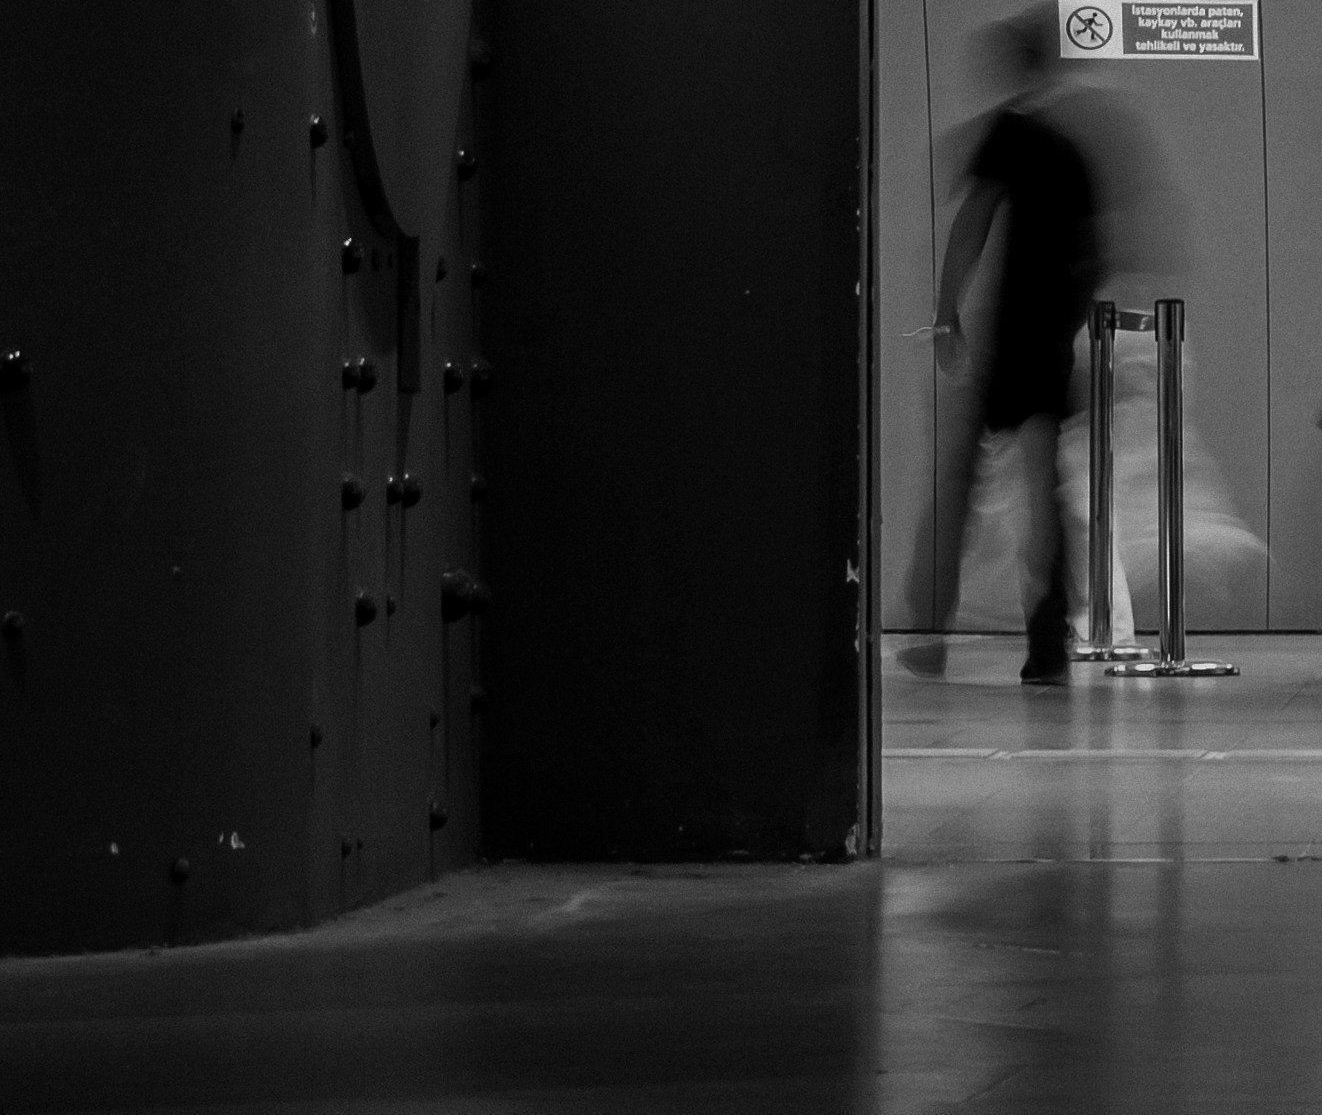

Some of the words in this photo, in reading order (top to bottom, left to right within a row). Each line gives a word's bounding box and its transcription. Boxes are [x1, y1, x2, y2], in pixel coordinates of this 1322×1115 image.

[1131, 4, 1206, 19] İstasyonlarda
[1208, 6, 1244, 19] paten,
[1138, 17, 1178, 29] kaykay
[1180, 17, 1198, 27] vb.
[1161, 29, 1219, 40] kullanmak
[1135, 40, 1180, 51] tehlikeli
[1182, 42, 1197, 51] ve
[1199, 41, 1245, 54] yasaktır.
